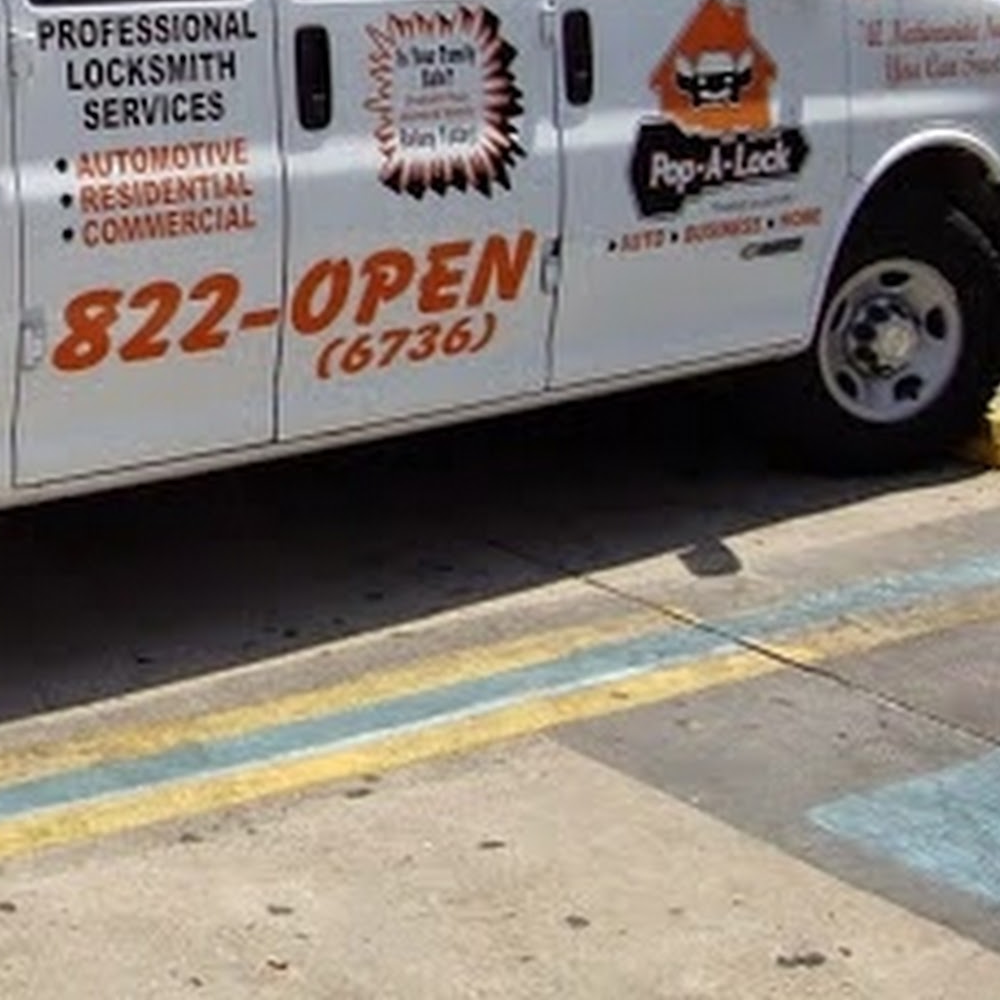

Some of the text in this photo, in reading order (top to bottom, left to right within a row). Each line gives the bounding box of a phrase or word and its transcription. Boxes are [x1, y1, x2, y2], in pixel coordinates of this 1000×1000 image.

[37, 10, 258, 51] PROFESSIONAL
[65, 50, 237, 91] LOCKSMITH
[82, 90, 225, 131] SERVICES
[76, 137, 249, 178] AUTOMOTIVE
[649, 138, 792, 194] Pop-A-Lock
[79, 172, 254, 214] RESIDENTIAL
[81, 204, 257, 248] COMMERCIAL
[50, 228, 537, 373] 822-OPEN
[314, 312, 498, 380] (6736)
